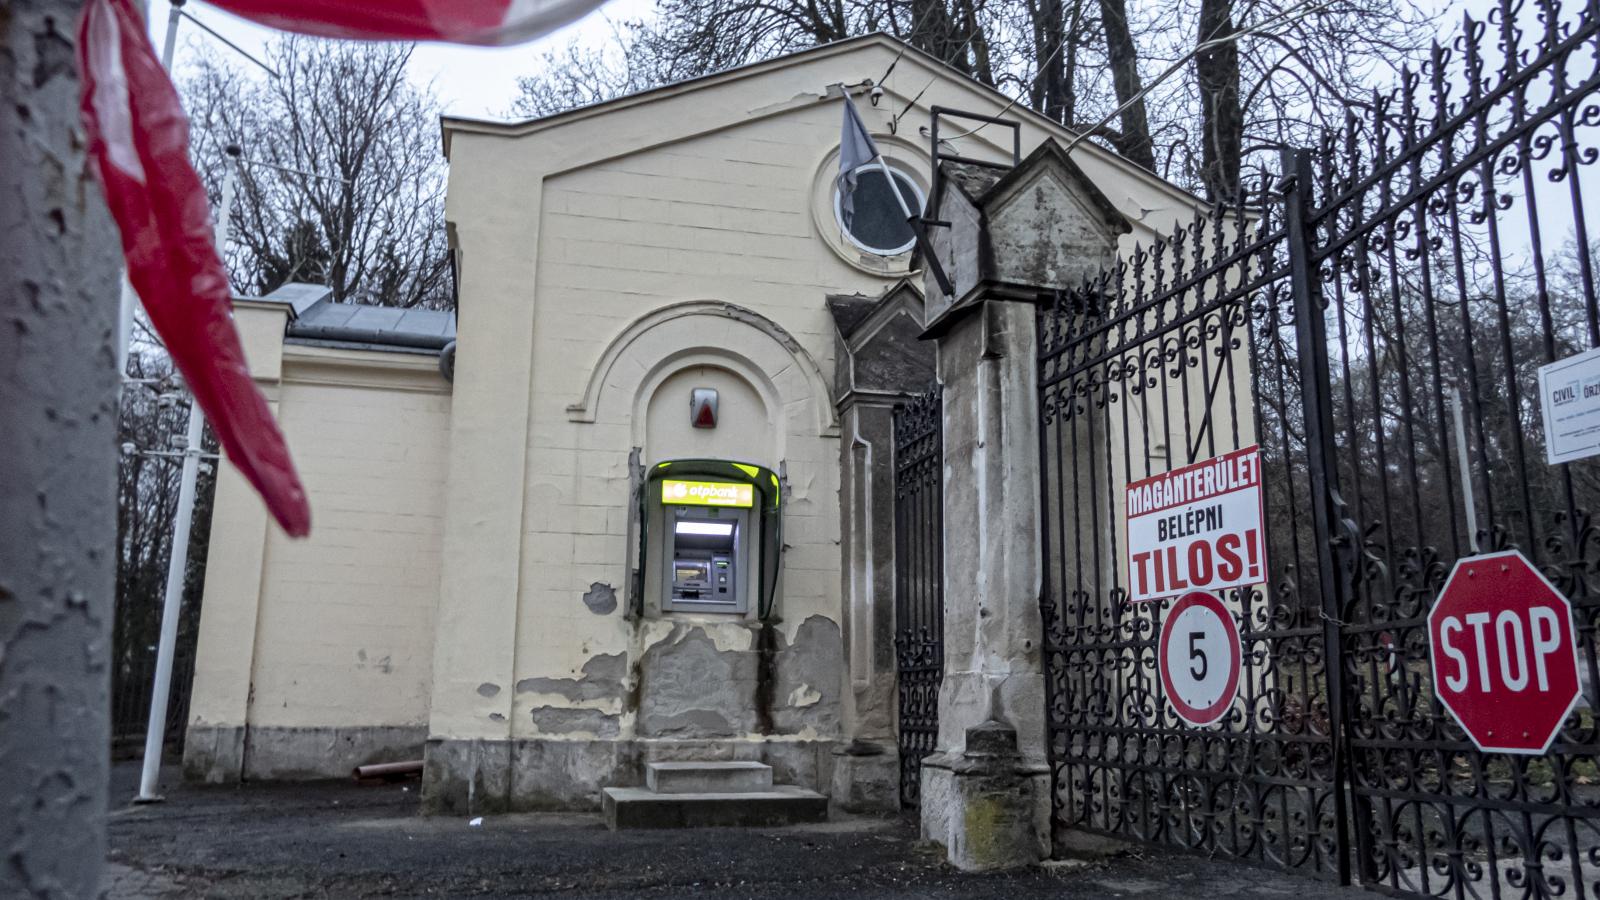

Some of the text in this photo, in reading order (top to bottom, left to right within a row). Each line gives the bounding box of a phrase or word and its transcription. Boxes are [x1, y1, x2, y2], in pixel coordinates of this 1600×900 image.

[1553, 387, 1576, 403] CIVIL
[1128, 451, 1259, 516] MAGÁNTERÜLET
[1158, 504, 1223, 541] BELÉPNI
[1133, 529, 1260, 595] TILOS!
[1189, 631, 1208, 682] 5
[1440, 606, 1561, 693] STOP
